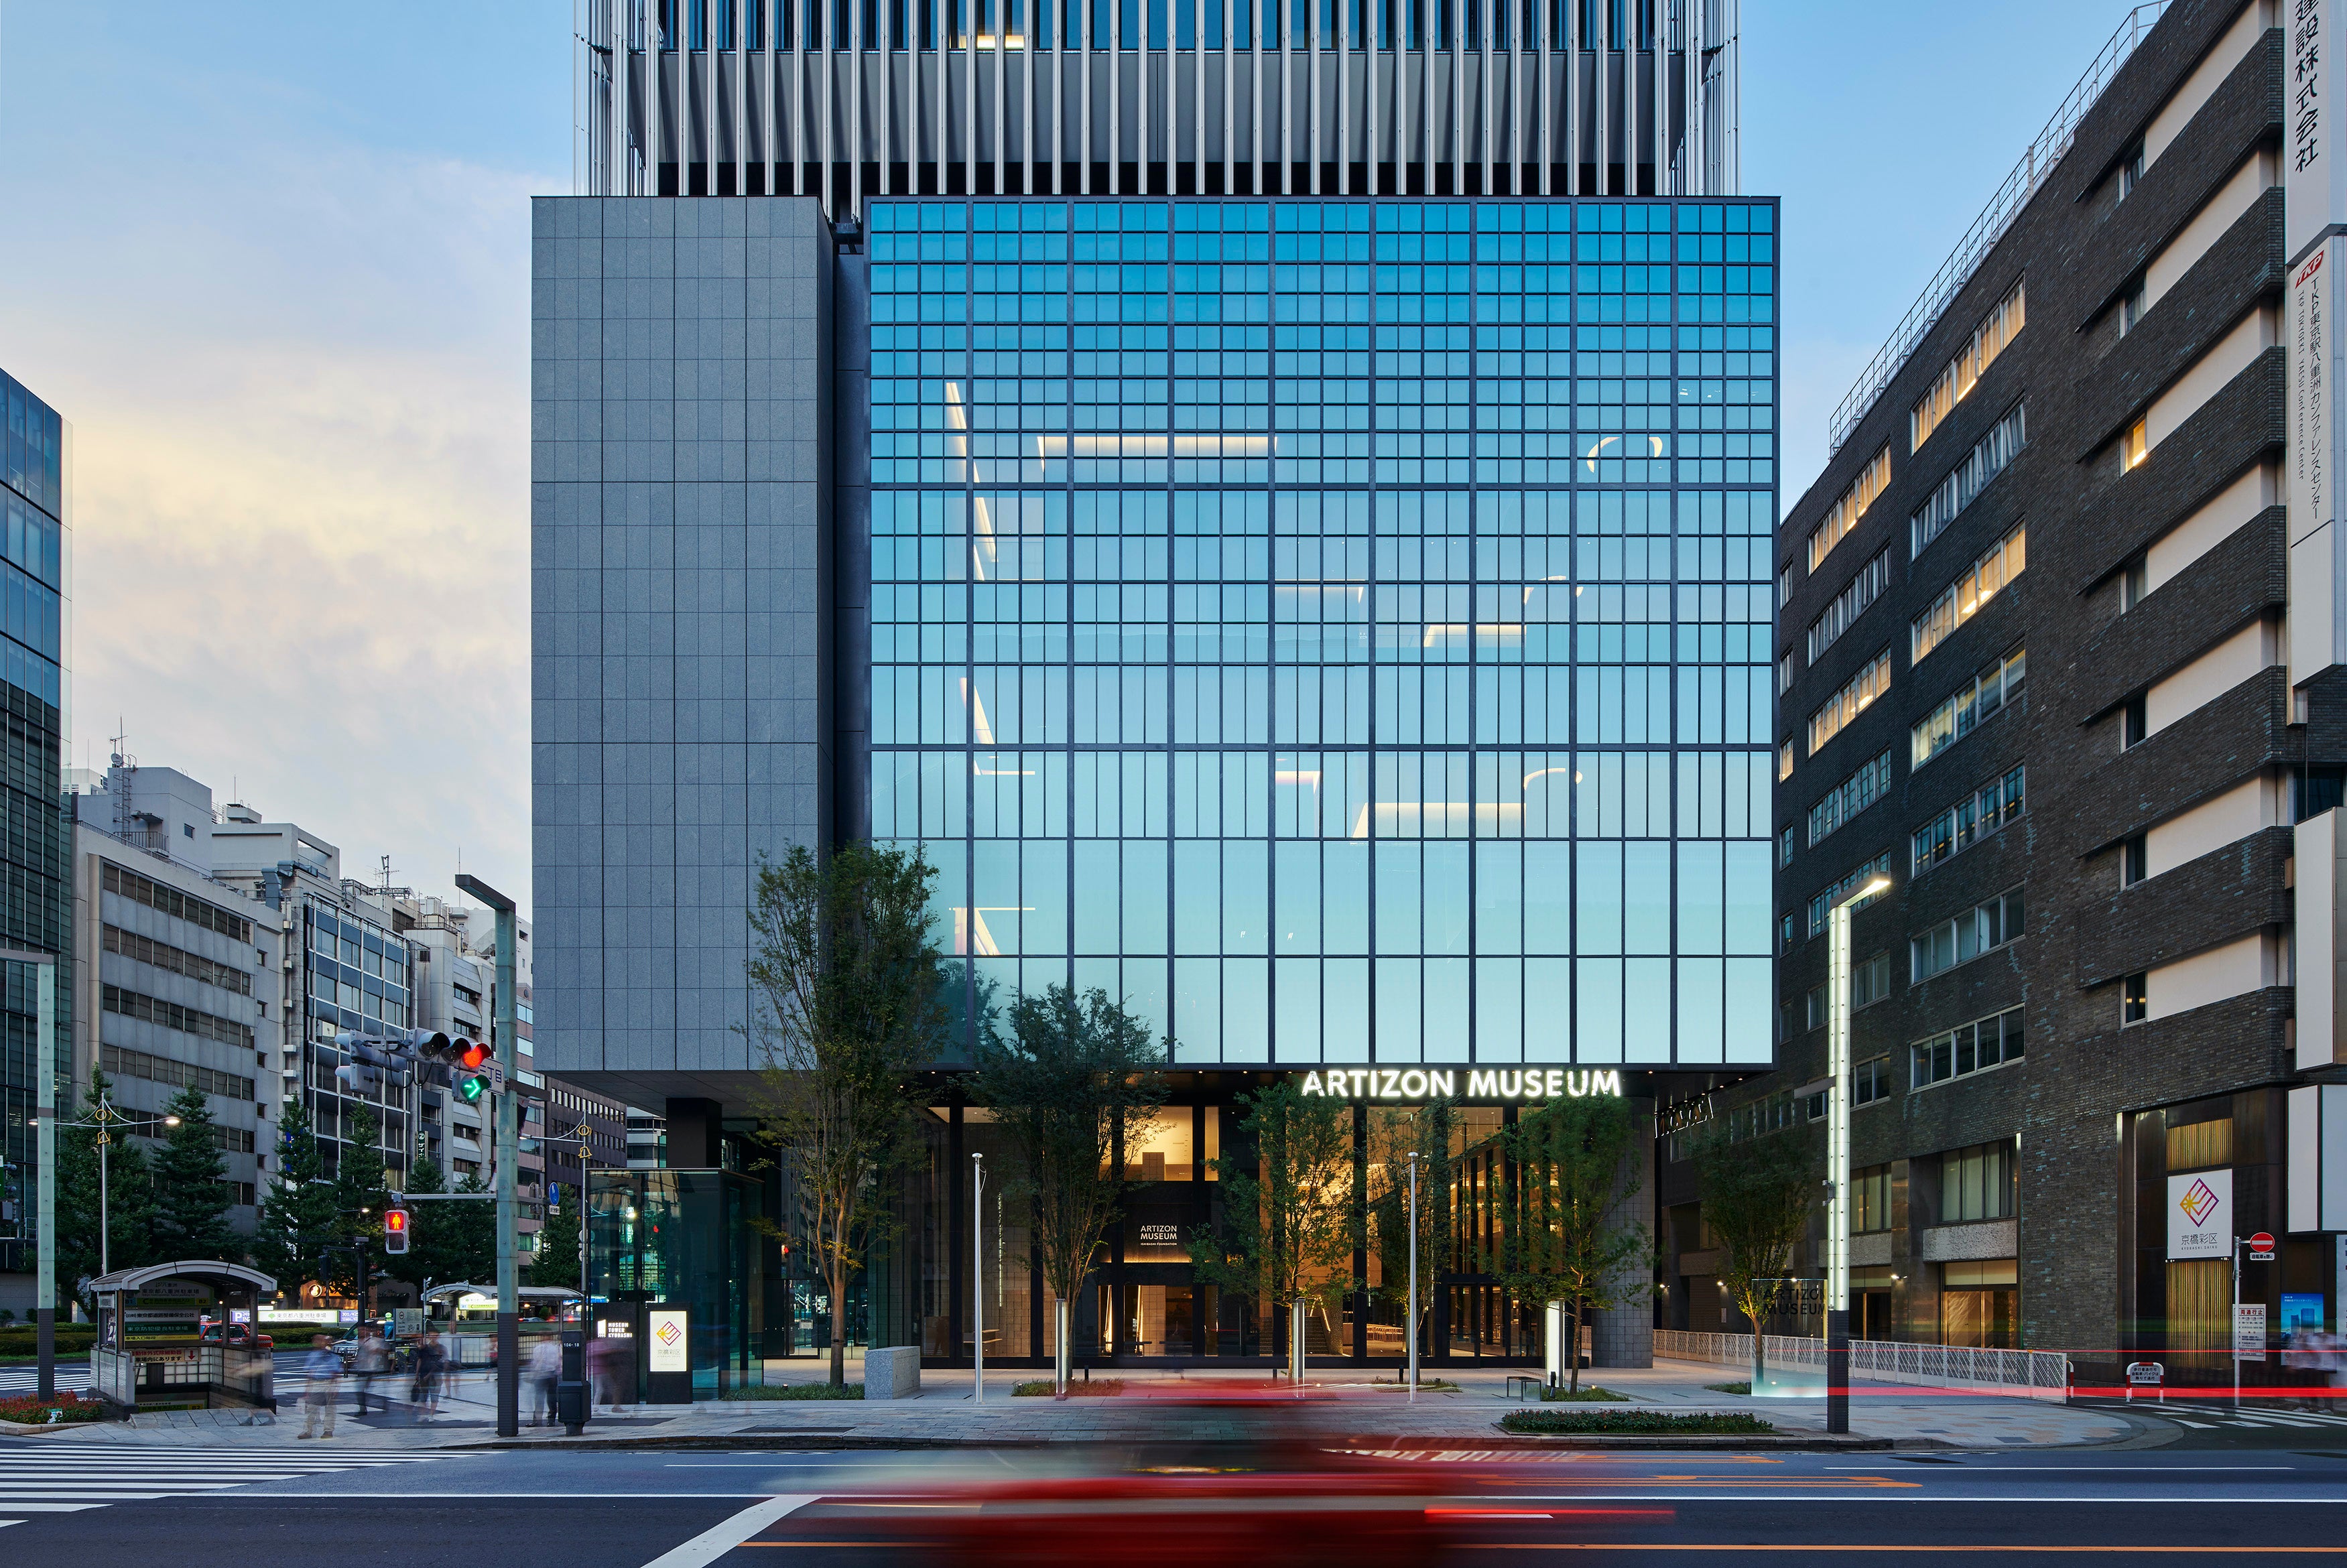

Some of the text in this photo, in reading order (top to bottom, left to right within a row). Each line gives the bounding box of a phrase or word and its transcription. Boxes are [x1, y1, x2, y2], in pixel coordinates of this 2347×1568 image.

[2297, 255, 2322, 284] TKP
[2309, 276, 2321, 519] TKP東京駅八重洲カンファレンスセンター
[2297, 389, 2305, 446] Conference
[1301, 1069, 1621, 1097] ARTIZON MUSEUM
[2181, 1232, 2218, 1245] 京橋彩区
[235, 1312, 243, 1322] P
